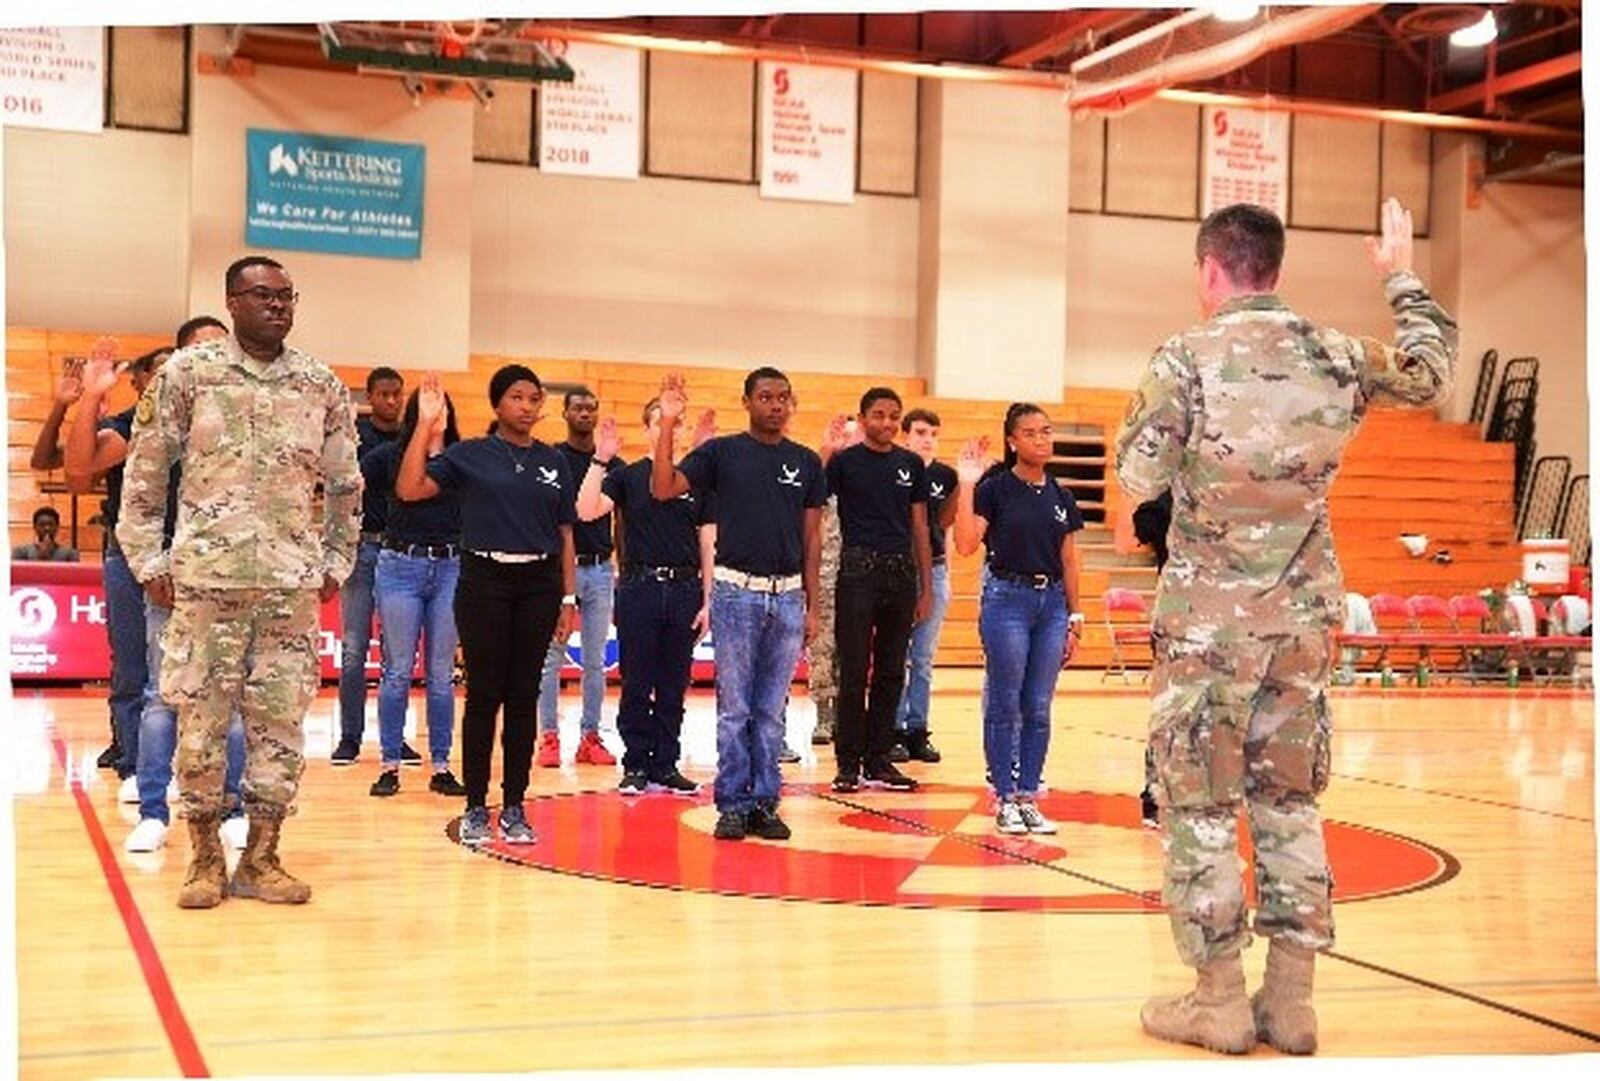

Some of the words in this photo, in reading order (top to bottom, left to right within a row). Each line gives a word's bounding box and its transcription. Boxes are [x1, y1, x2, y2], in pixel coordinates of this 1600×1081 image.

[20, 68, 65, 81] PLACE
[4, 95, 42, 114] 016
[297, 147, 402, 174] KETTERING
[545, 144, 591, 165] 2018
[255, 201, 278, 216] We
[281, 202, 318, 218] Care
[321, 205, 347, 221] For
[350, 210, 412, 227] Athletes
